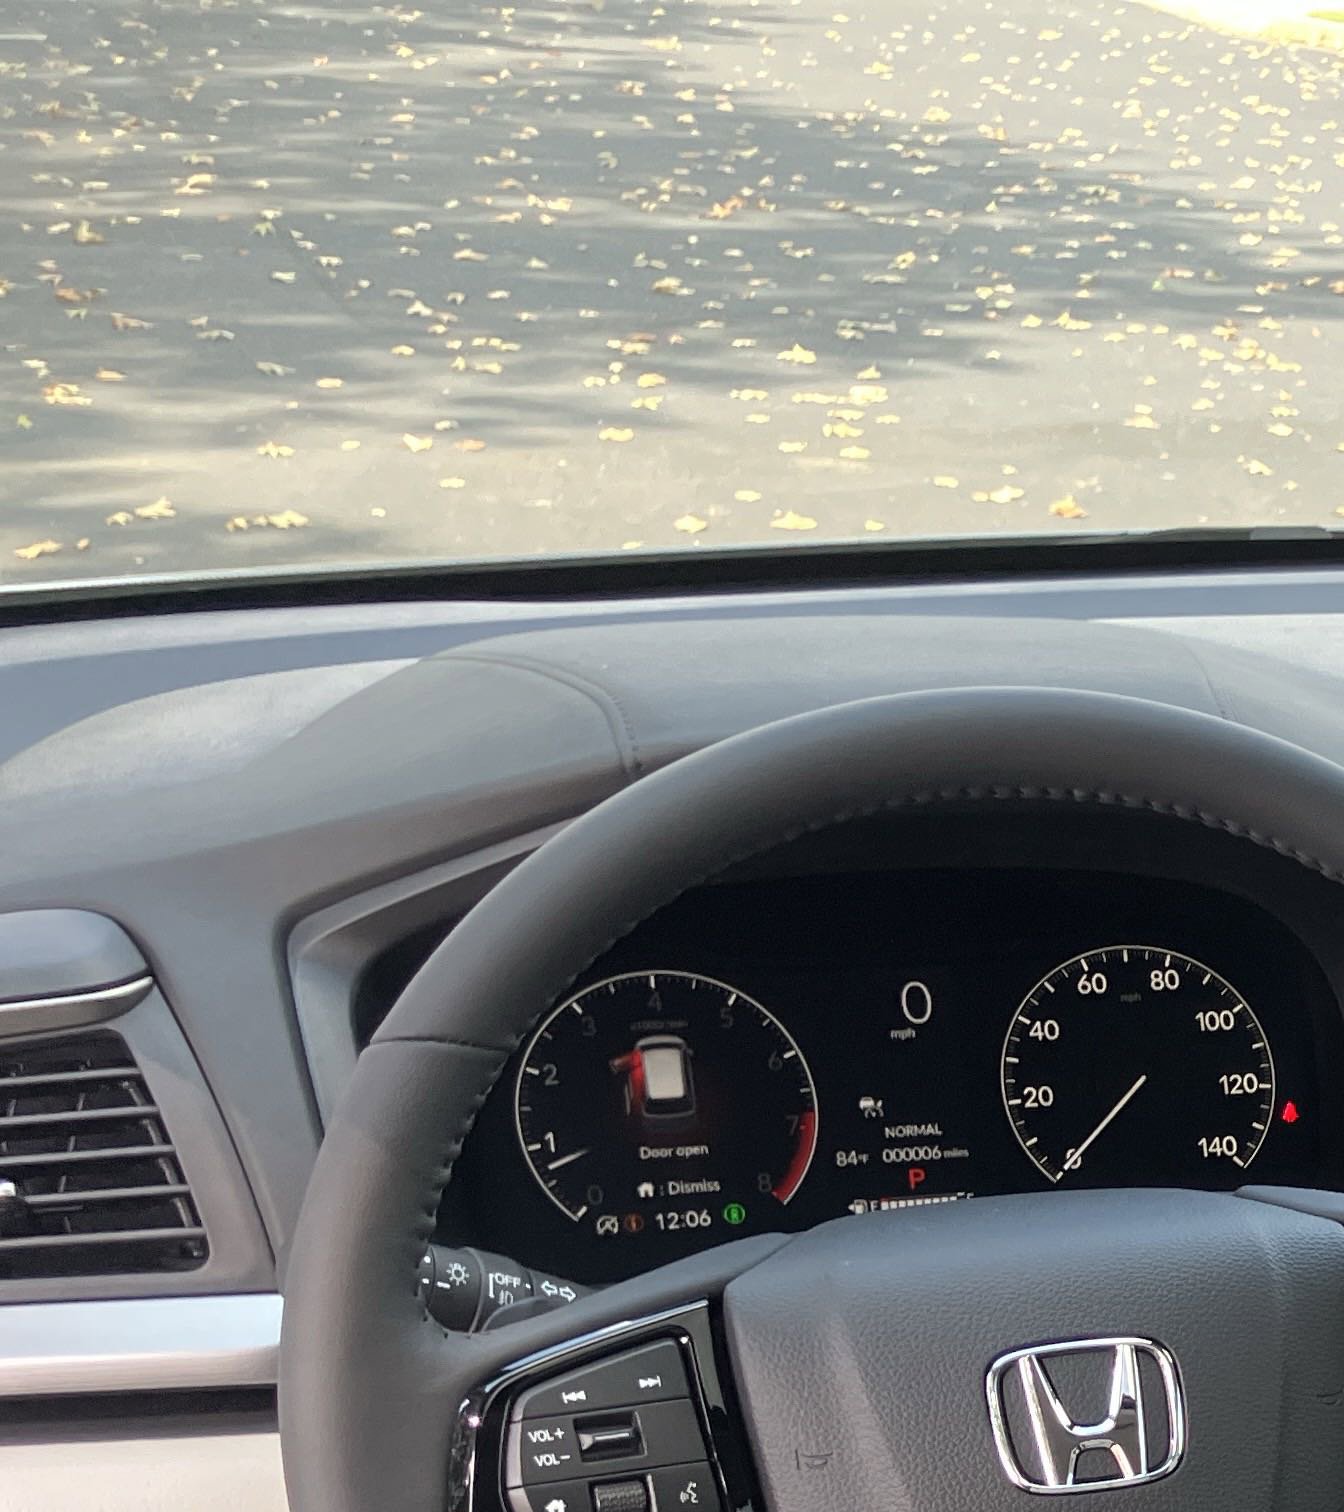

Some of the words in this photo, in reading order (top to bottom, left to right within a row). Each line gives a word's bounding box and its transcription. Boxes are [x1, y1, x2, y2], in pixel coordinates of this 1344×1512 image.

[1077, 973, 1107, 994] 60
[1150, 969, 1180, 991] 80
[901, 980, 932, 1024] 0
[1029, 1019, 1060, 1041] 40
[1194, 1009, 1235, 1032] 100
[890, 1027, 916, 1040] mph
[543, 1064, 559, 1086] 2
[1219, 1072, 1258, 1096] 120
[1023, 1085, 1054, 1108] 20
[884, 1122, 943, 1139] NORMAL
[544, 1131, 556, 1153] 1
[639, 1146, 673, 1160] Door
[675, 1145, 709, 1160] open
[1198, 1135, 1238, 1157] 140
[882, 1145, 942, 1163] 000006
[943, 1147, 970, 1159] miles
[668, 1178, 721, 1196] Dismiss
[908, 1167, 926, 1190] P
[655, 1208, 712, 1230] 12:06
[494, 1272, 521, 1288] OFF
